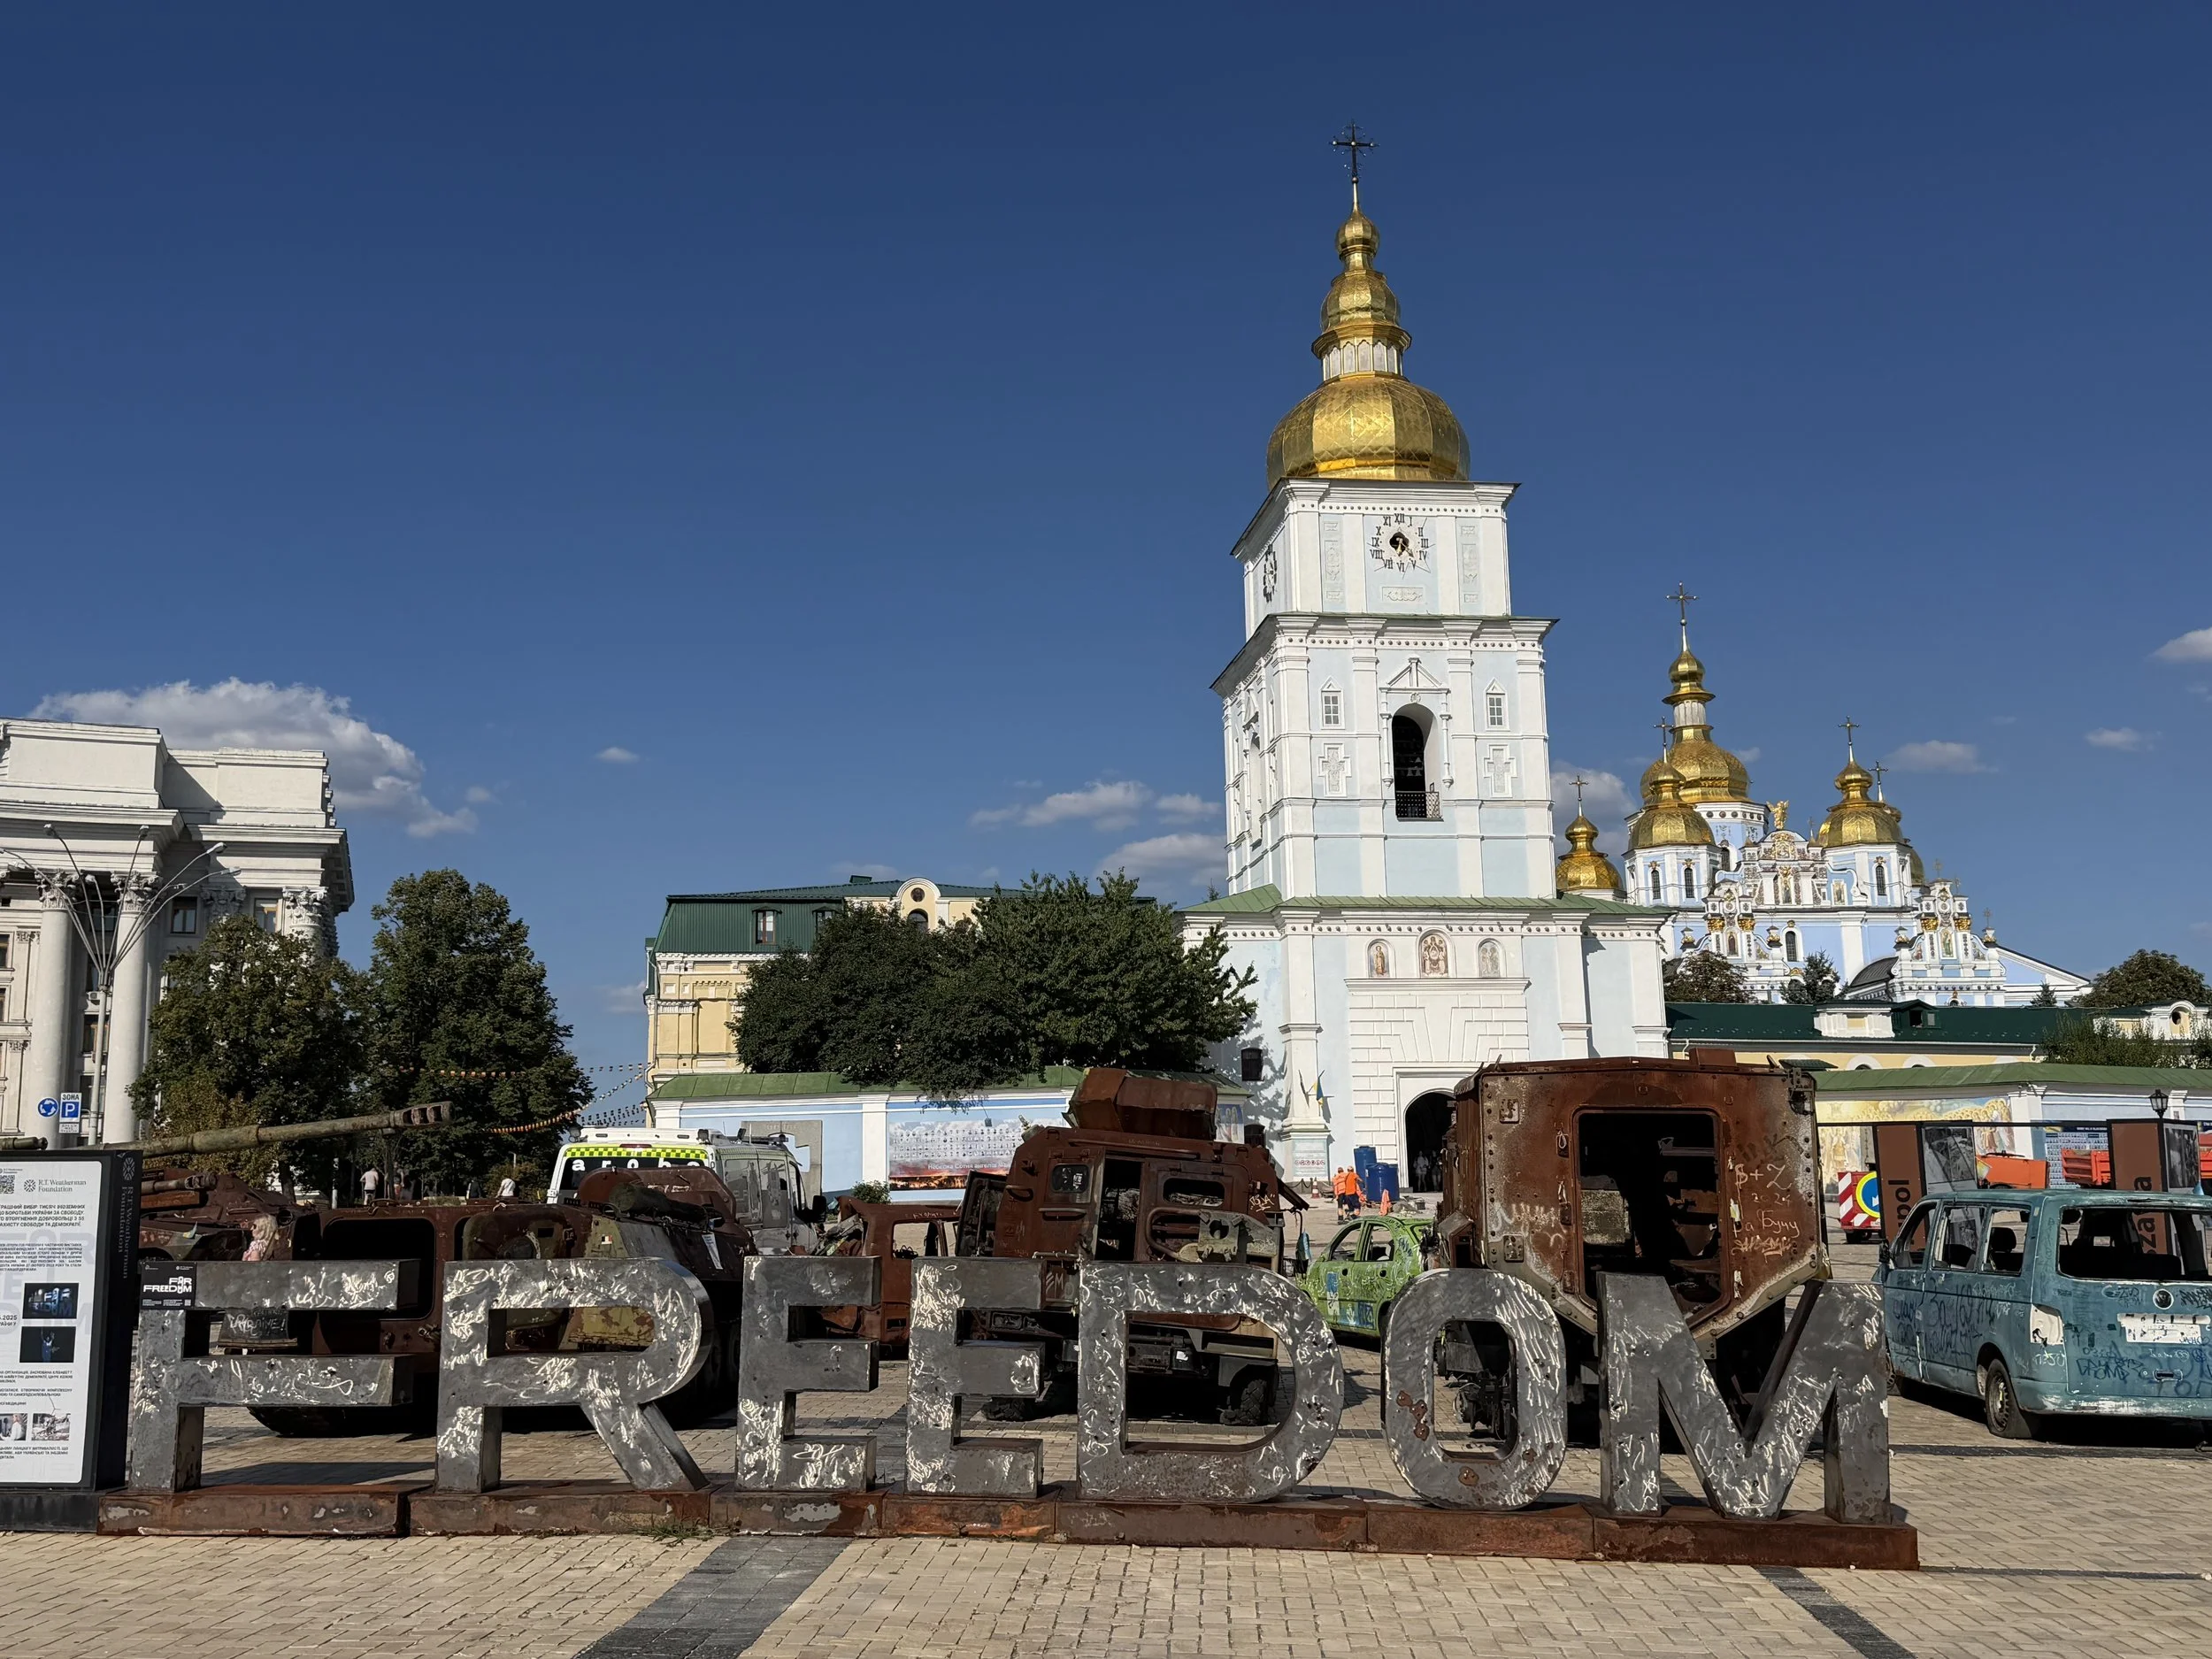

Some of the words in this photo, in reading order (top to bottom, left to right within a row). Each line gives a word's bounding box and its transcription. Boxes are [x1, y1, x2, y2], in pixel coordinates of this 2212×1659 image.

[1383, 516, 1392, 526] XI
[1394, 513, 1405, 524] XII
[1376, 526, 1382, 536] X
[1417, 527, 1424, 537] II
[1371, 537, 1380, 547] IX
[1370, 549, 1384, 560] VIII
[1418, 550, 1427, 560] IV
[1383, 559, 1394, 569] VII
[1396, 562, 1405, 572] VI
[1410, 560, 1417, 570] V
[142, 1284, 193, 1294] FREEDOM
[128, 1255, 1891, 1524] FREEDOM
